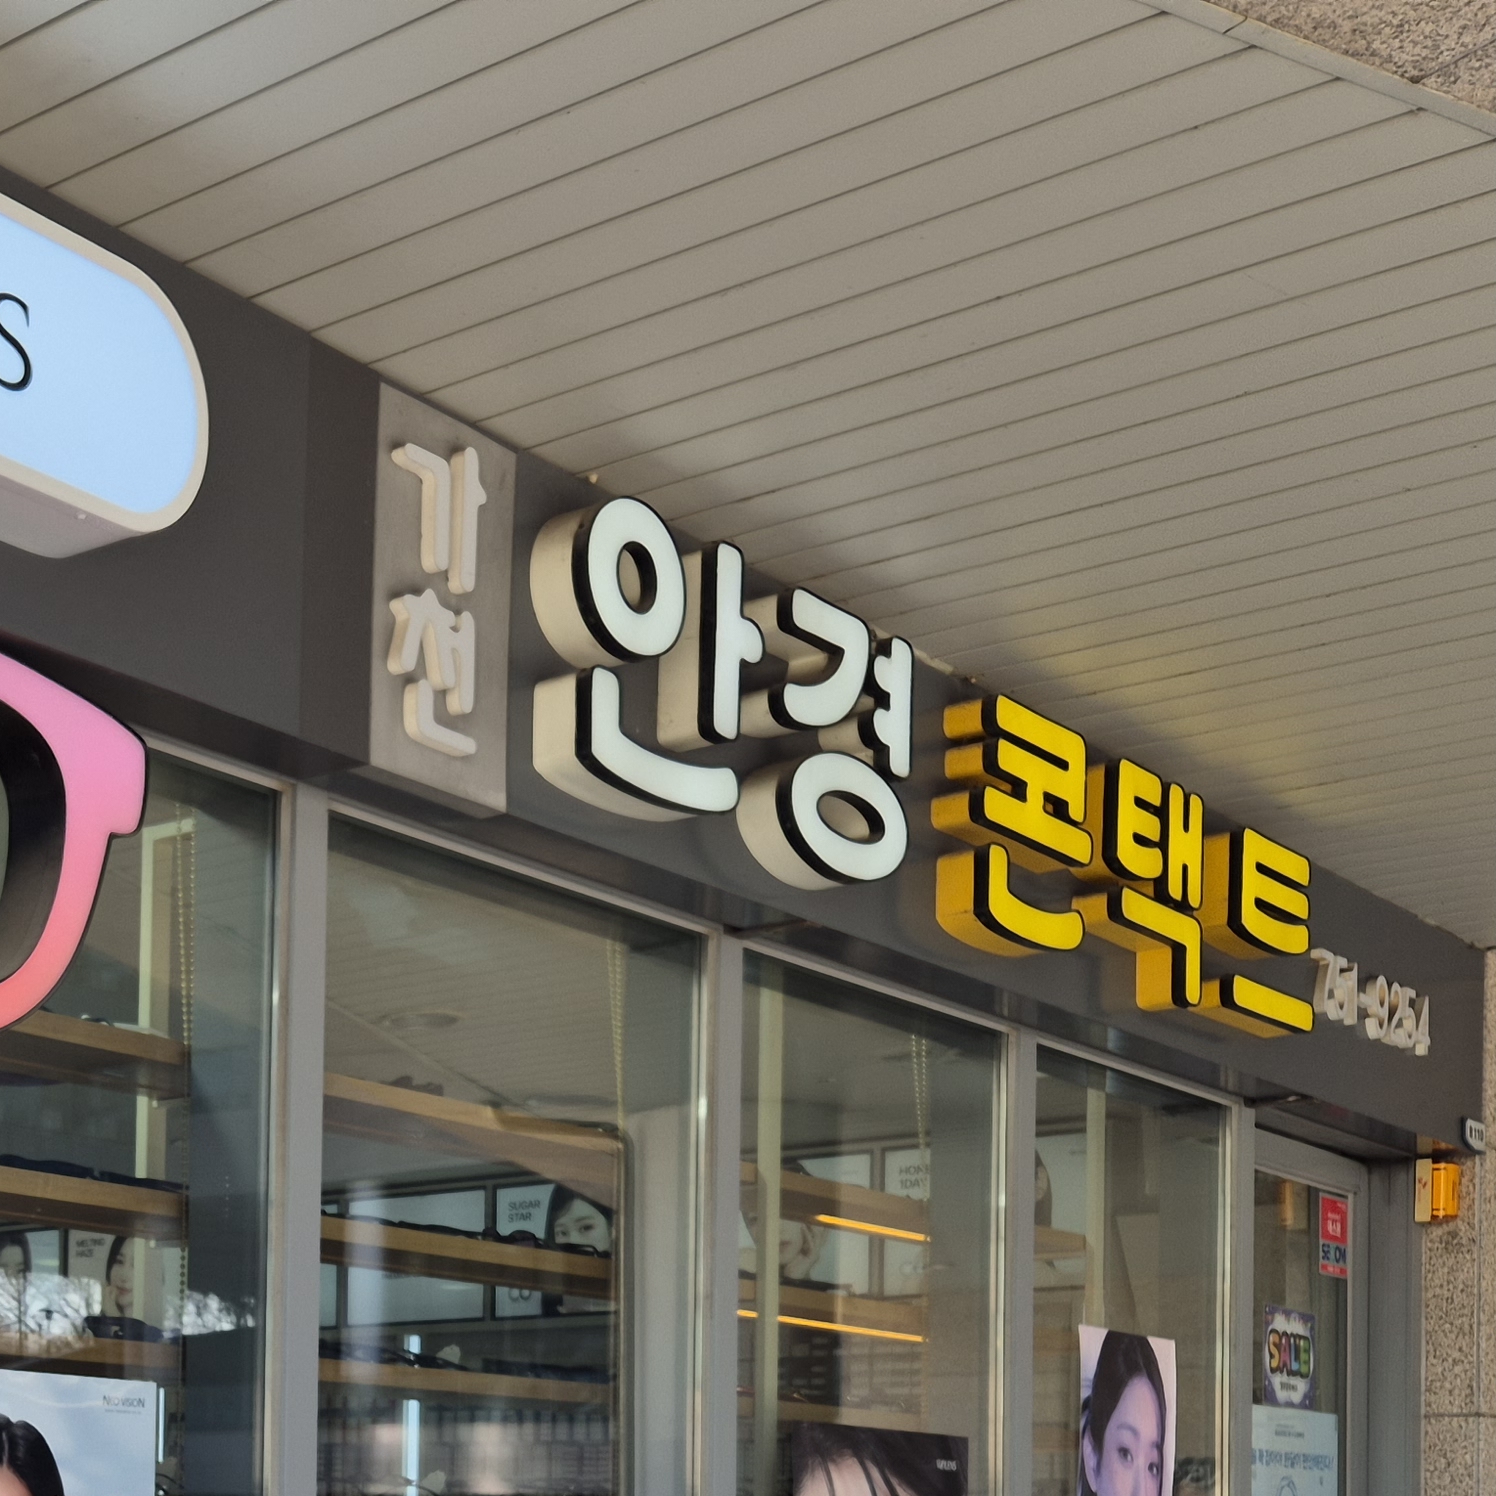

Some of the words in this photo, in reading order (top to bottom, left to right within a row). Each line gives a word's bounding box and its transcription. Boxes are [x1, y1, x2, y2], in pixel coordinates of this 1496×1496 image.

[388, 443, 487, 757] 가천
[562, 496, 914, 886] 안경
[956, 694, 1315, 1034] 콘택트
[1310, 948, 1430, 1056] 751-9254
[508, 1200, 541, 1211] SUGAR
[508, 1212, 531, 1223] STAR
[1267, 1328, 1311, 1379] SALE
